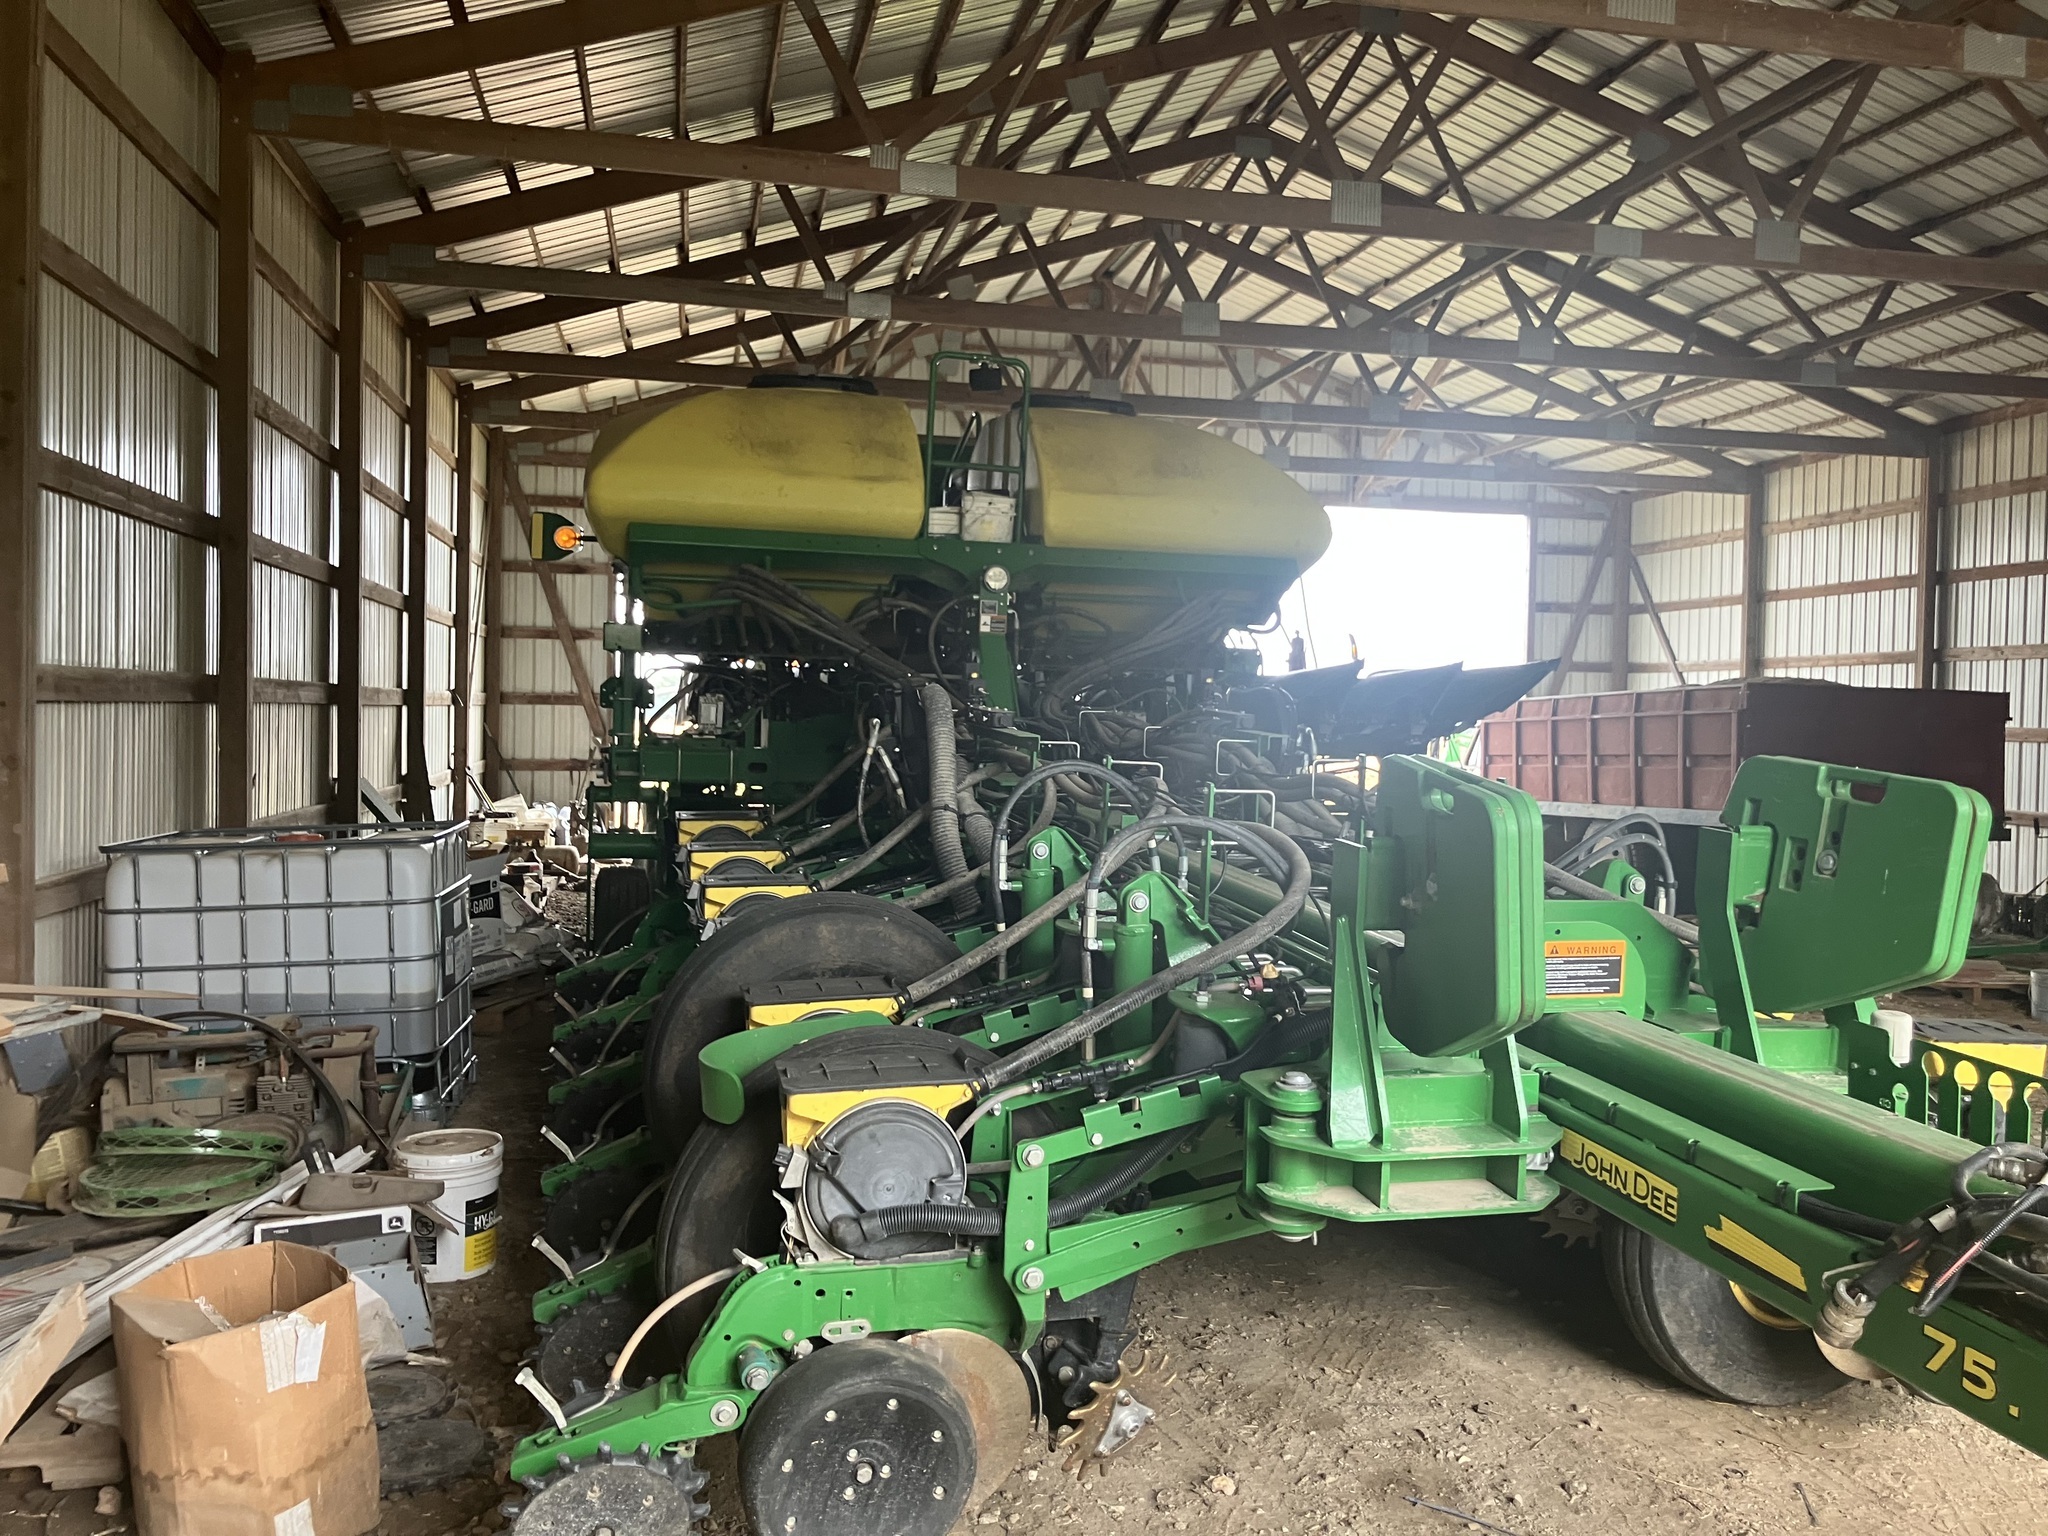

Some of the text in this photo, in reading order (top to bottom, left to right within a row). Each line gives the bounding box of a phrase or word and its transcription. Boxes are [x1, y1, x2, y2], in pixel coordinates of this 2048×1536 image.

[470, 896, 494, 914] -GARD
[1566, 945, 1617, 955] WARNING
[1573, 1142, 1628, 1192] JOHN
